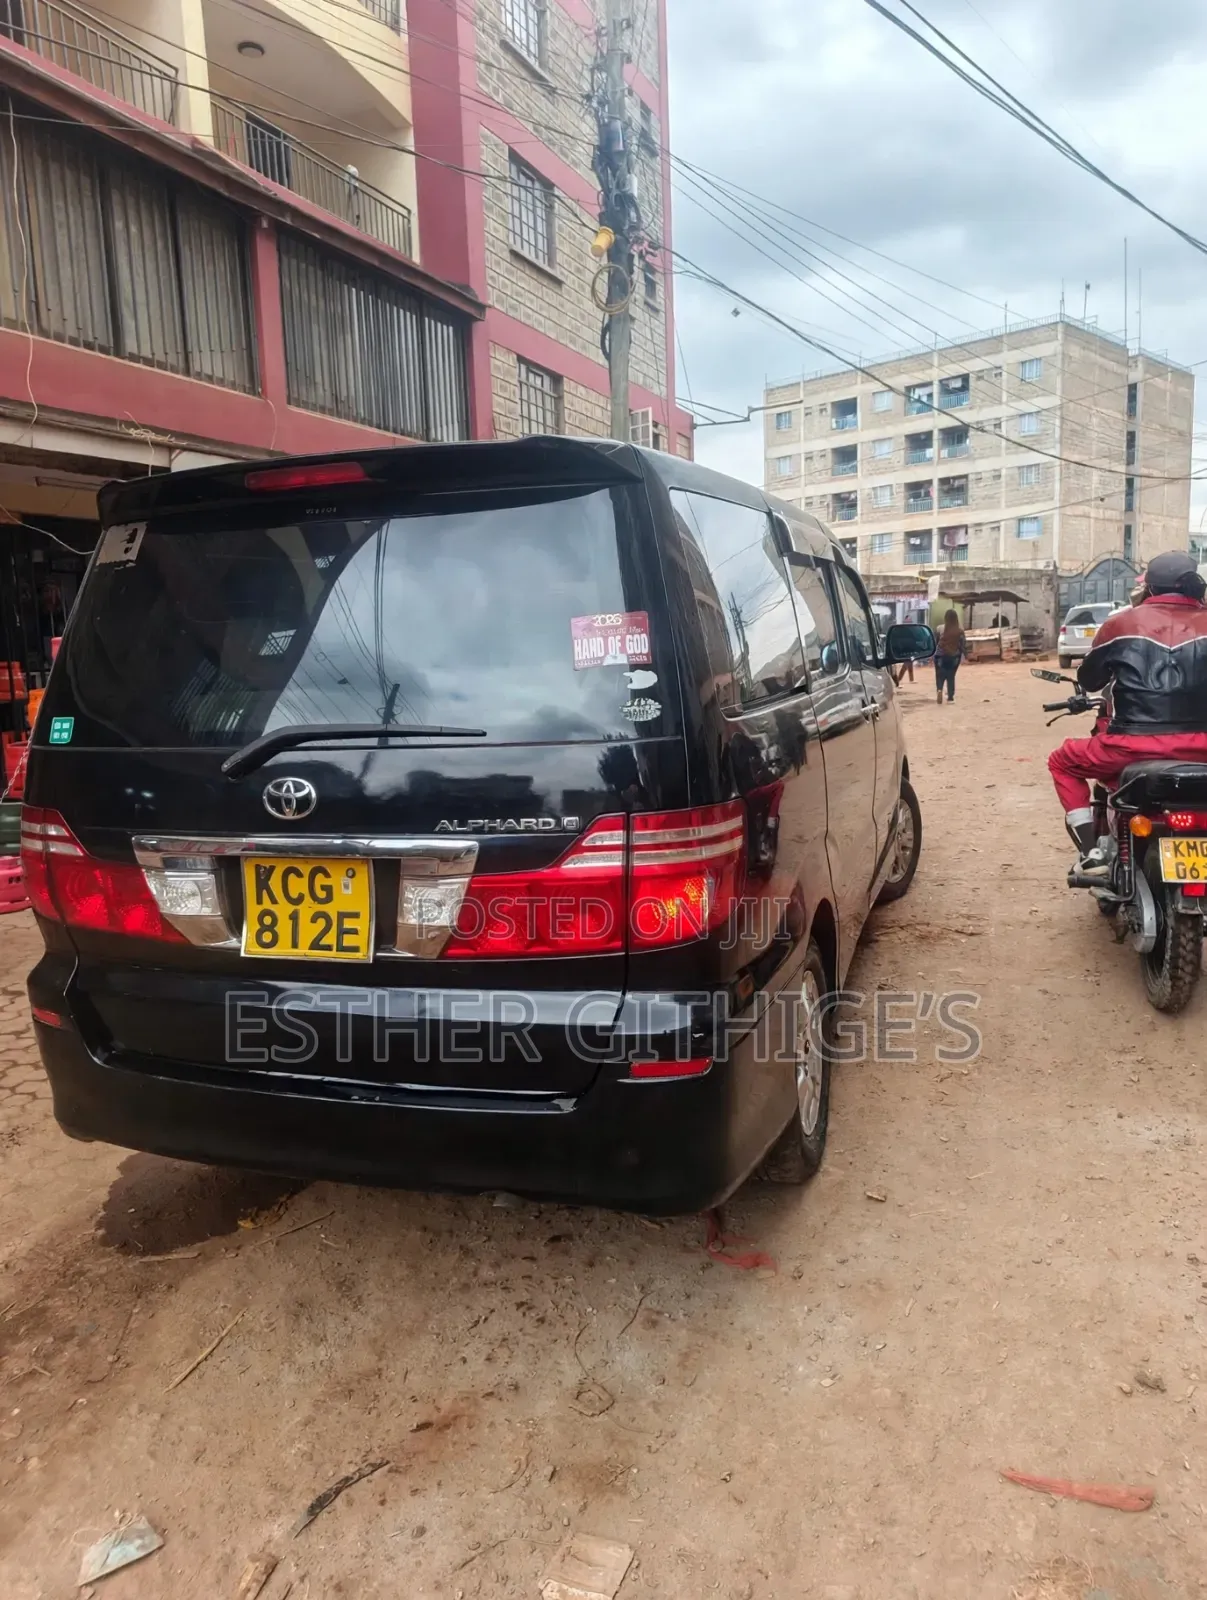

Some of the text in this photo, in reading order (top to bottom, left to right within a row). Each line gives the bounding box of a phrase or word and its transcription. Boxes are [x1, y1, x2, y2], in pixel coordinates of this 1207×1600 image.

[574, 633, 649, 661] HAND OF GOD
[433, 818, 556, 832] ALPHARD
[255, 864, 334, 906] KCG
[255, 908, 361, 953] 812E
